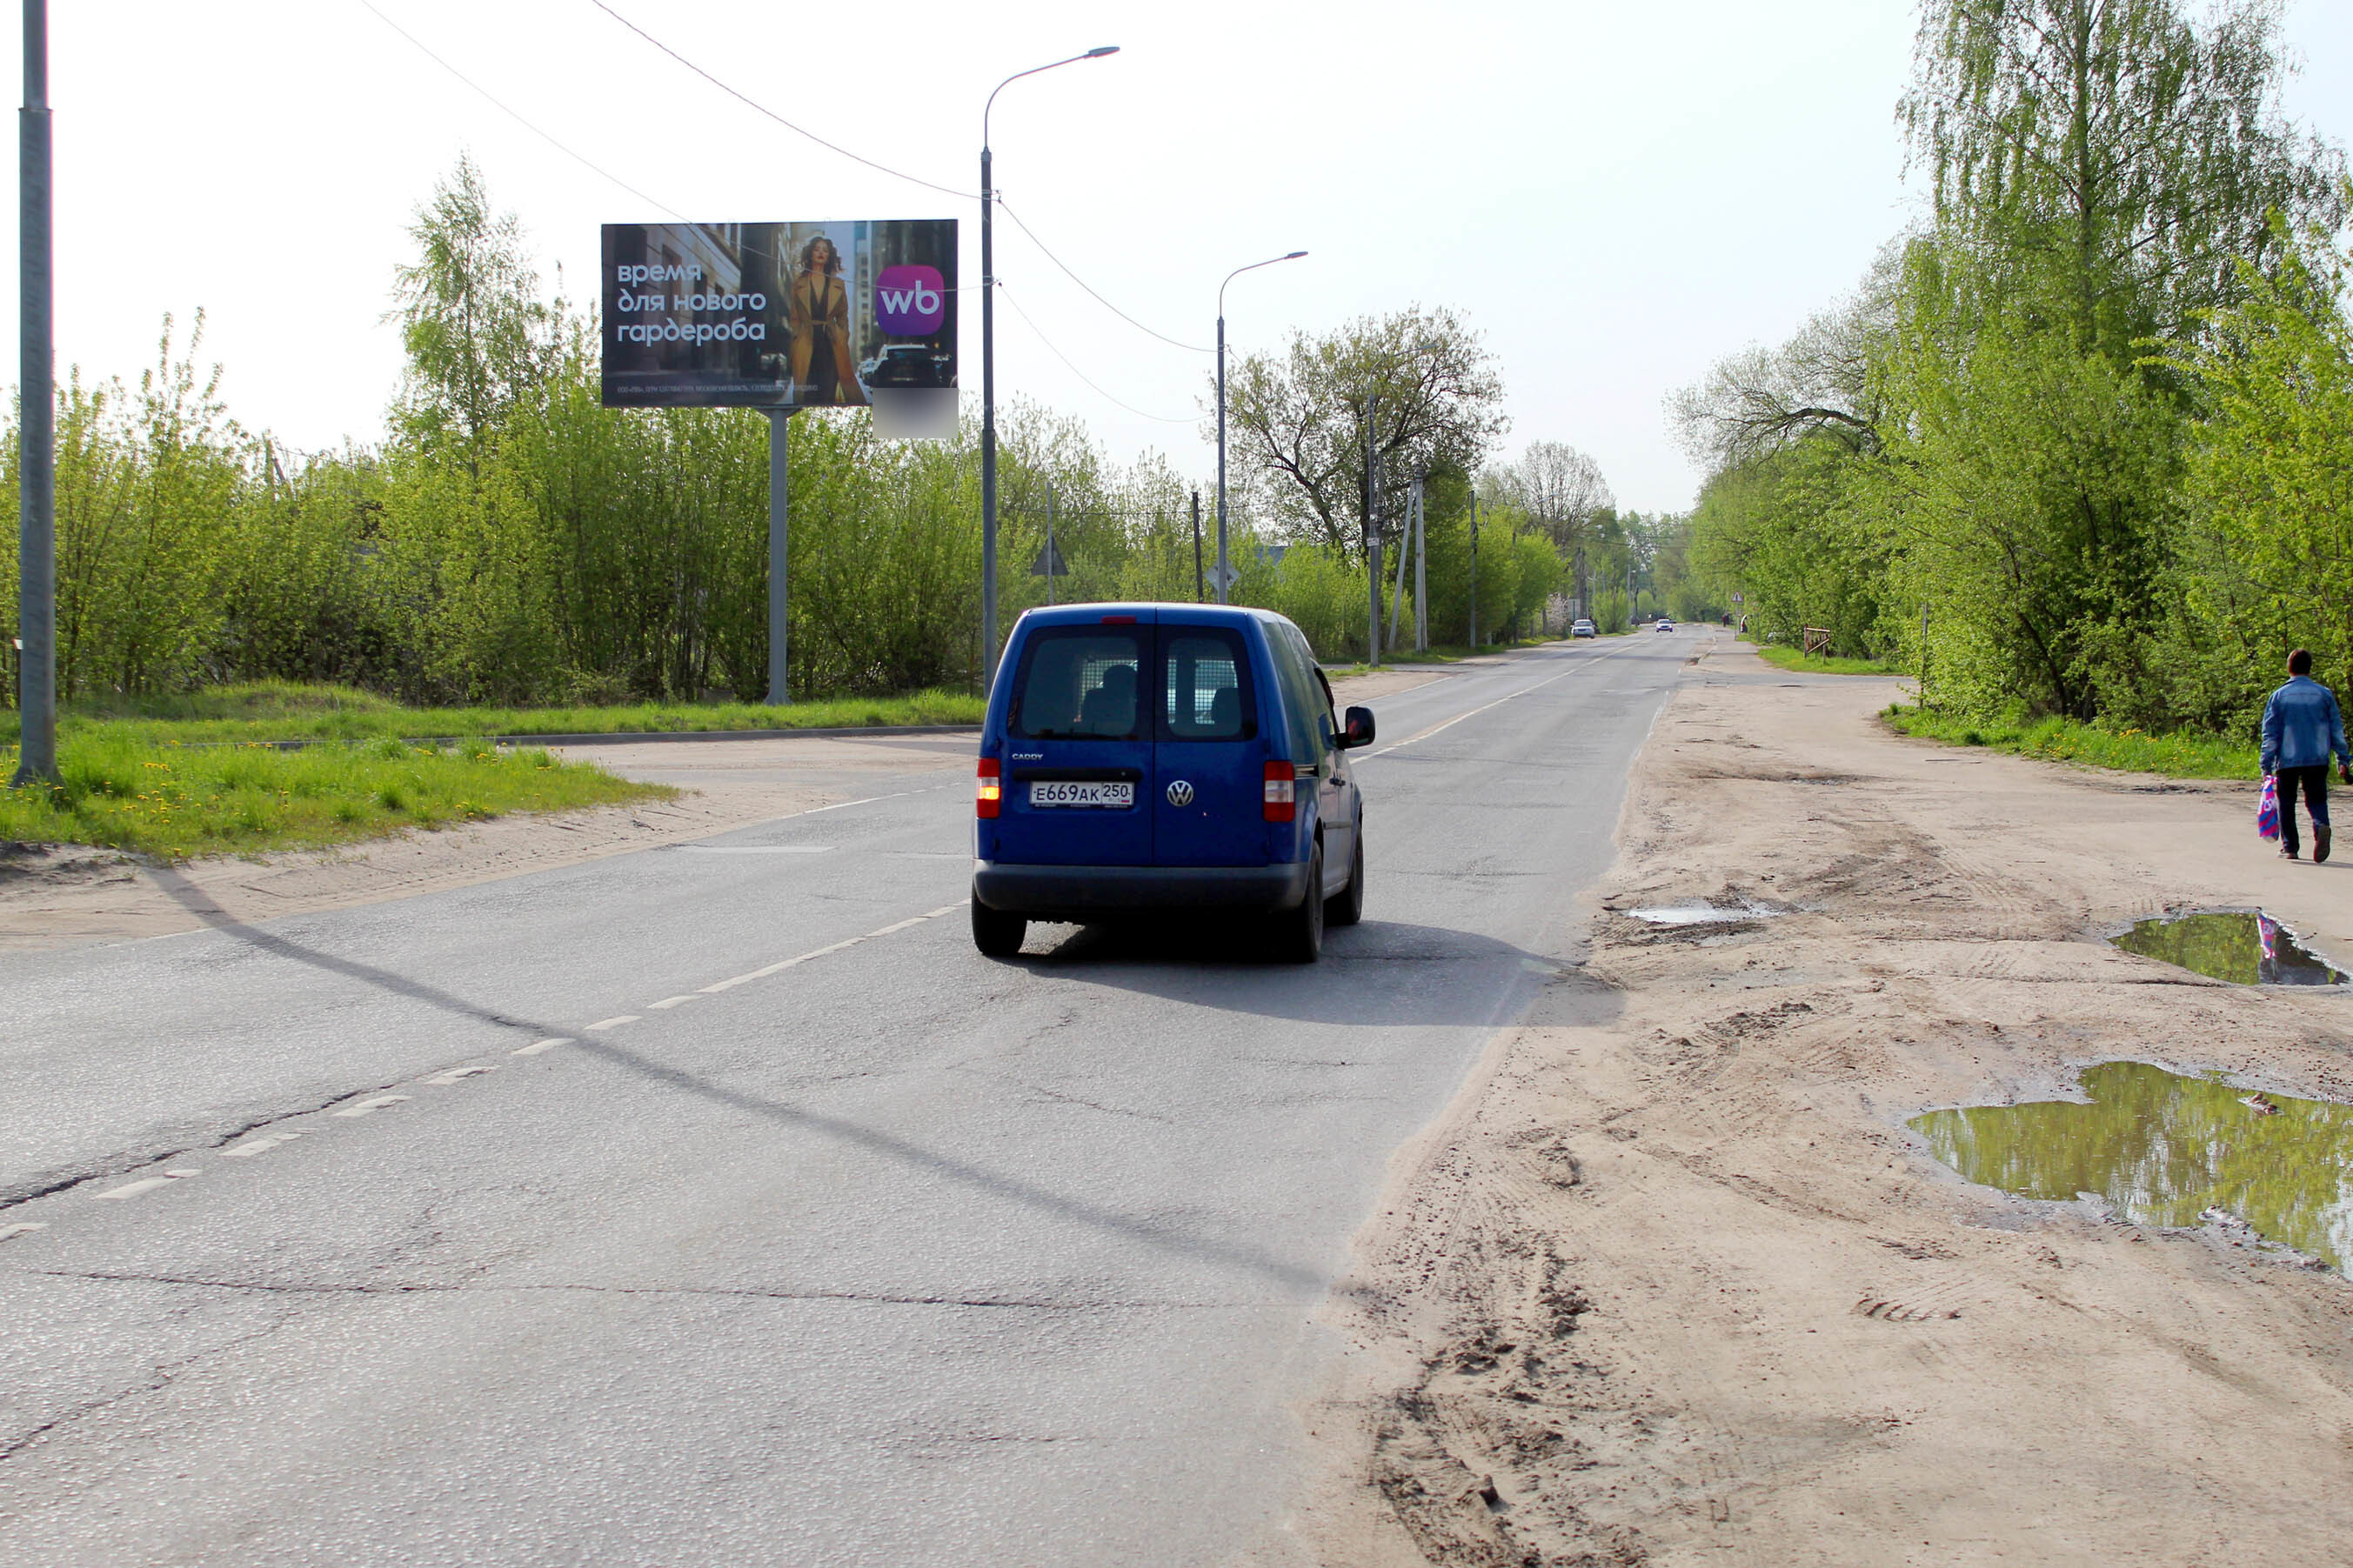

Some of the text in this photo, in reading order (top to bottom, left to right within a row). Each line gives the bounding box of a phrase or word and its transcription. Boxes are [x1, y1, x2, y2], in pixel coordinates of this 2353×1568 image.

[618, 264, 702, 288] время
[618, 289, 766, 312] для нового
[880, 280, 940, 316] wb
[617, 317, 765, 347] гардероба
[1103, 784, 1128, 797] 250
